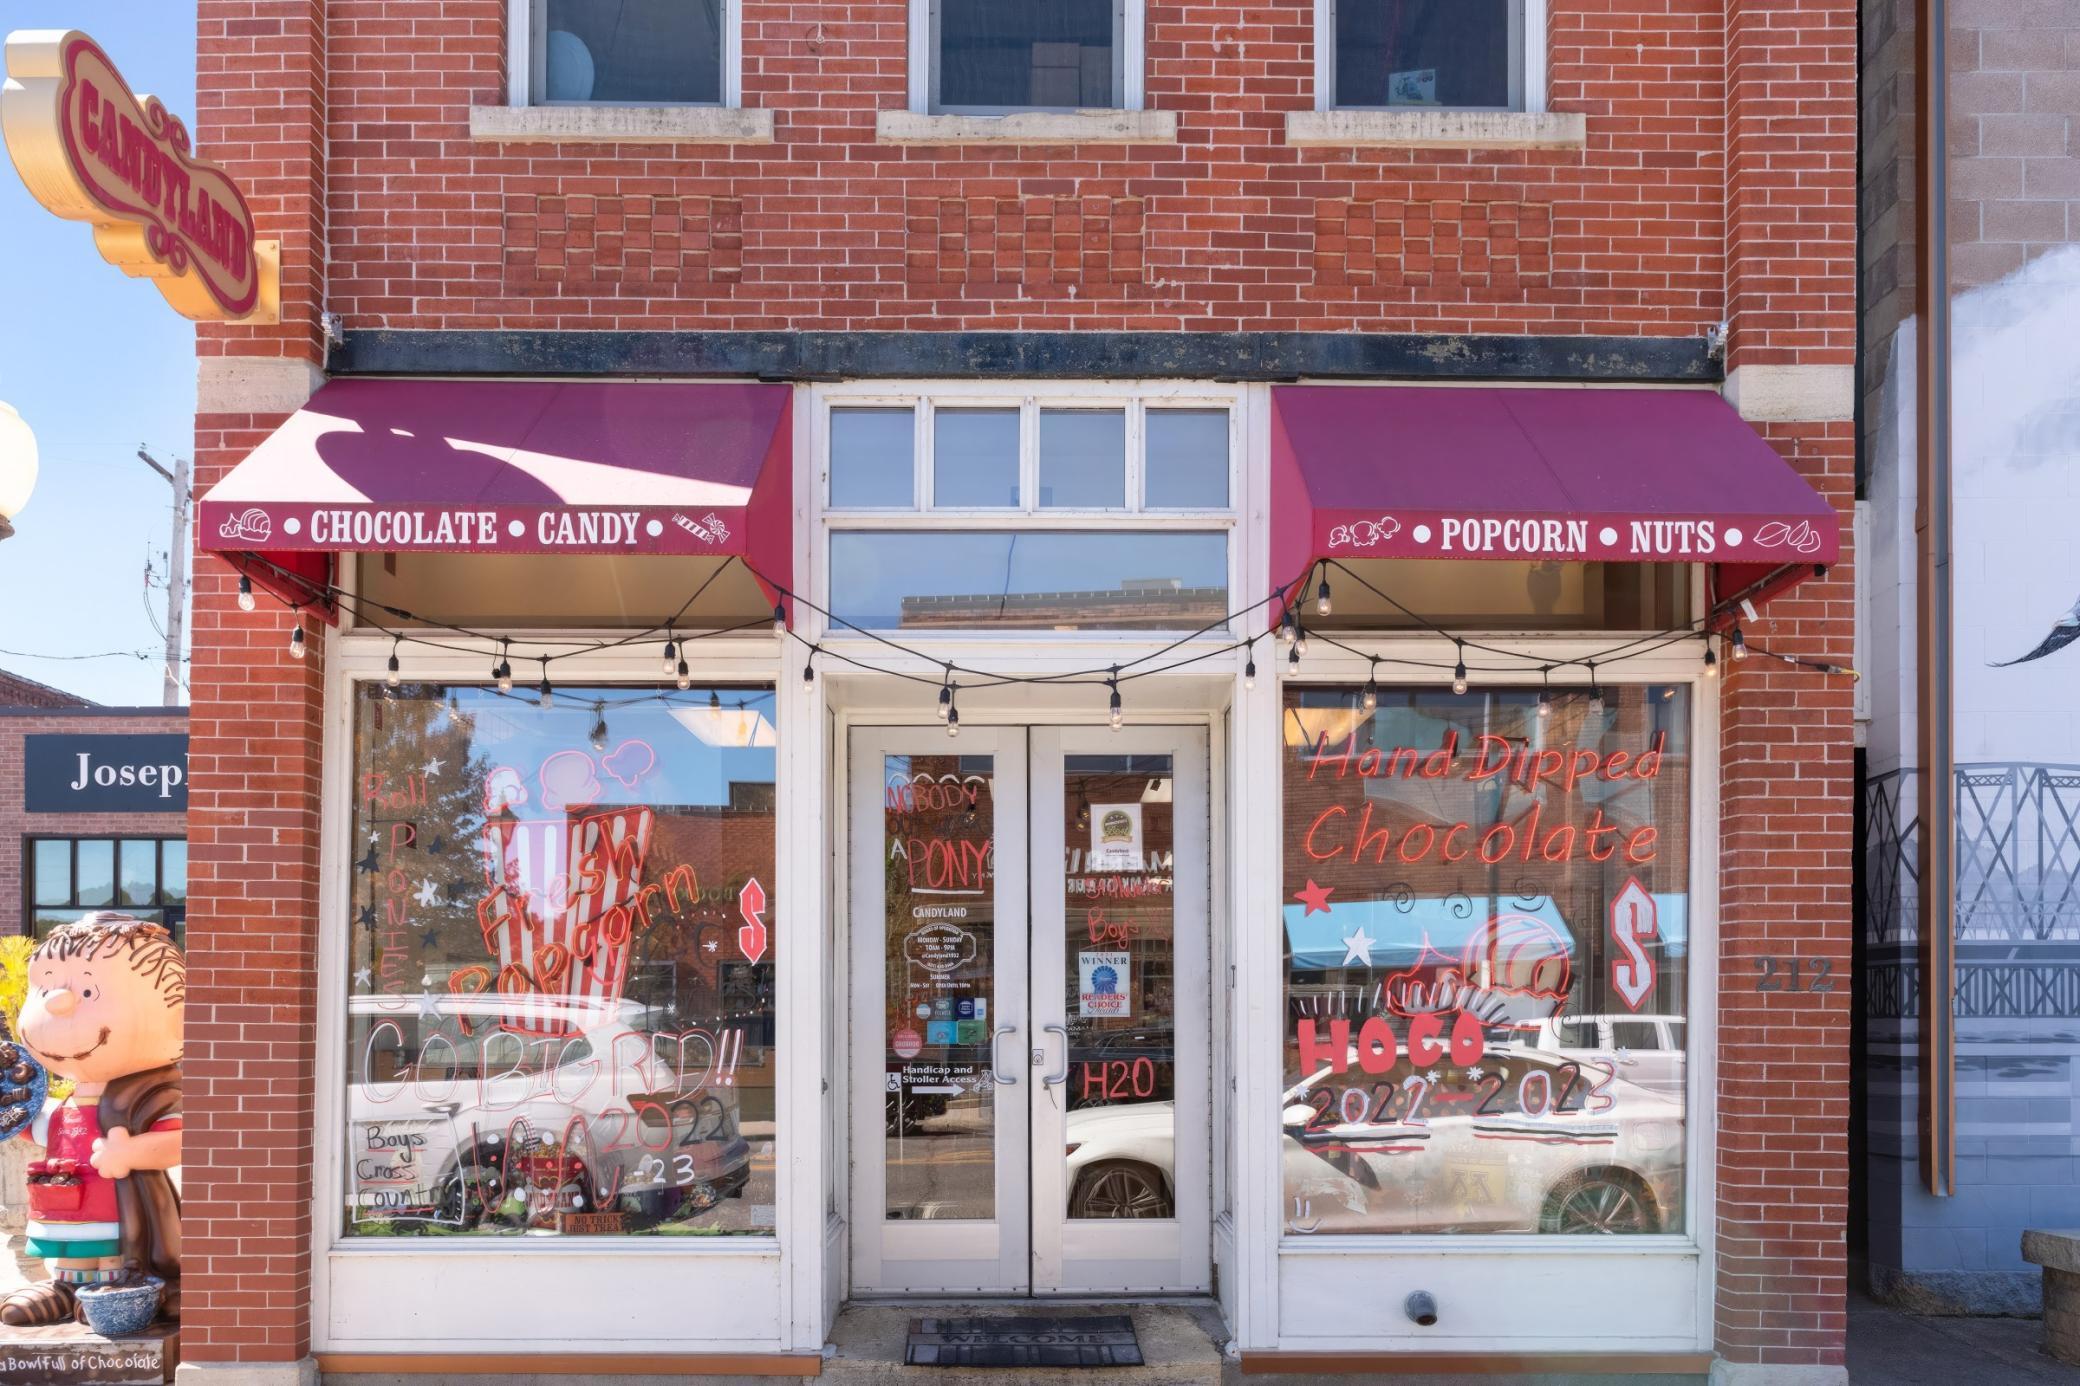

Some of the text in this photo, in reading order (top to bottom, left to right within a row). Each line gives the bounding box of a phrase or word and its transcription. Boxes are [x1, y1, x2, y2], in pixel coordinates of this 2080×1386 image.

[78, 77, 247, 283] CANDYLAND
[310, 509, 640, 546] CHOCOLATE CANDY
[1441, 518, 1716, 555] POPCORN NUTS
[70, 753, 189, 798] Josep
[1305, 729, 1667, 793] Hand Dipped
[363, 773, 427, 812] Roll
[886, 783, 977, 816] NOBODY
[1304, 800, 1660, 866] Chocolate
[890, 837, 991, 889] A PONY
[475, 819, 645, 957] Fresh
[912, 906, 968, 918] CANDYLAND
[448, 863, 700, 1037] Popcorn
[1081, 956, 1128, 965] WINNER
[1753, 955, 1837, 992] 212
[1297, 1011, 1485, 1078] HOCO
[902, 1065, 973, 1075] Handicap and
[902, 1076, 977, 1084] Stroller Access
[598, 1096, 729, 1153] 2022
[367, 1125, 427, 1163] Boys
[356, 1158, 418, 1181] Cross
[942, 1333, 1107, 1345] WELCOME
[71, 1356, 88, 1371] of
[88, 1352, 161, 1370] Chocolate
